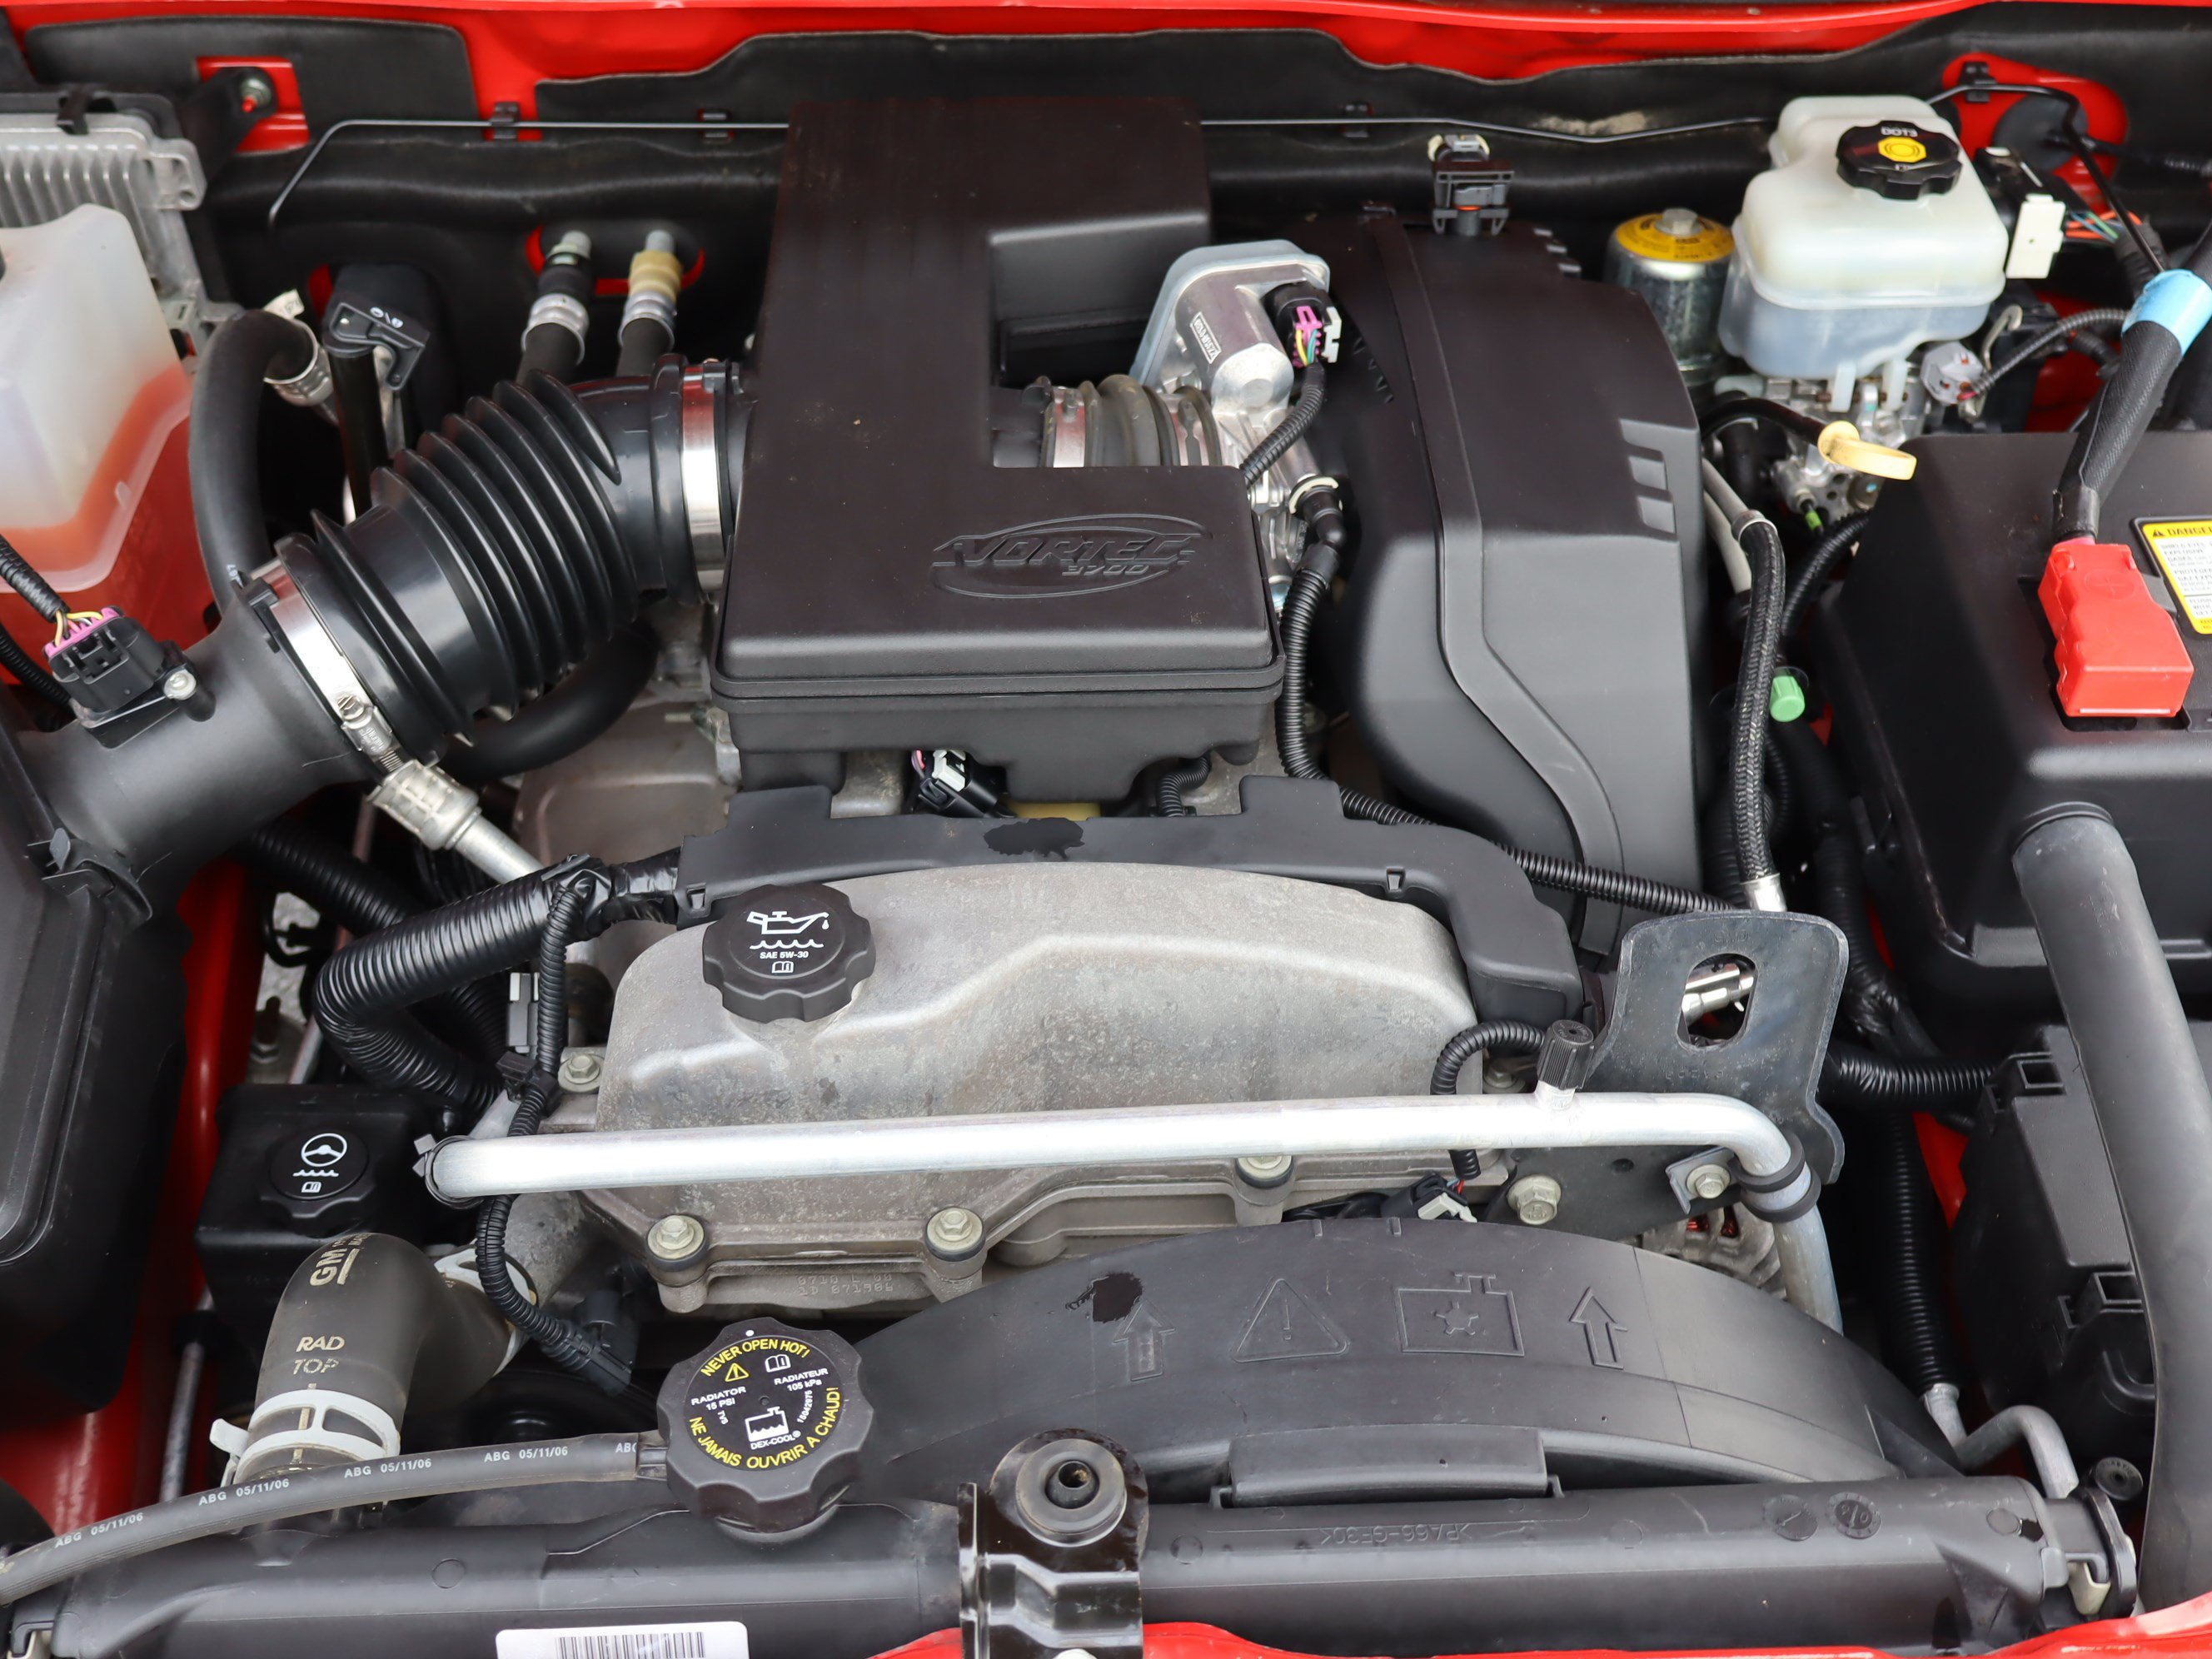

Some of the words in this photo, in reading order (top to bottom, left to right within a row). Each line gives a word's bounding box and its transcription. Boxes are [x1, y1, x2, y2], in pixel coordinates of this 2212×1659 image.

[1881, 126, 1918, 137] DOT3
[934, 536, 1194, 566] VORTEC
[1062, 565, 1150, 576] 3700
[760, 951, 778, 959] SAE
[780, 950, 810, 959] 5W-30
[310, 1248, 348, 1287] GM
[296, 1336, 346, 1353] RAD
[293, 1358, 340, 1375] TOP
[700, 1344, 743, 1378] NEVER
[741, 1338, 779, 1353] OPEN
[780, 1339, 811, 1358] HOT!
[774, 1368, 829, 1386] RADIATEUR
[787, 1382, 804, 1392] 105
[804, 1379, 823, 1388] kPa
[690, 1386, 747, 1406] RADIATOR
[705, 1402, 718, 1411] 15
[718, 1397, 736, 1408] PSI
[815, 1387, 839, 1437] CHAUD!
[690, 1416, 707, 1437] NE
[698, 1437, 743, 1467] JAMAIS
[746, 1444, 809, 1469] OUVRIR
[55, 1532, 82, 1549] ABG
[91, 1512, 144, 1537] 05/11/06
[198, 1491, 227, 1506] ABG
[236, 1477, 290, 1497] 05/11/06
[344, 1466, 372, 1478] ABG
[380, 1458, 432, 1473] 05/11/06
[484, 1451, 511, 1462] ABG
[519, 1446, 569, 1459] 05/11/06
